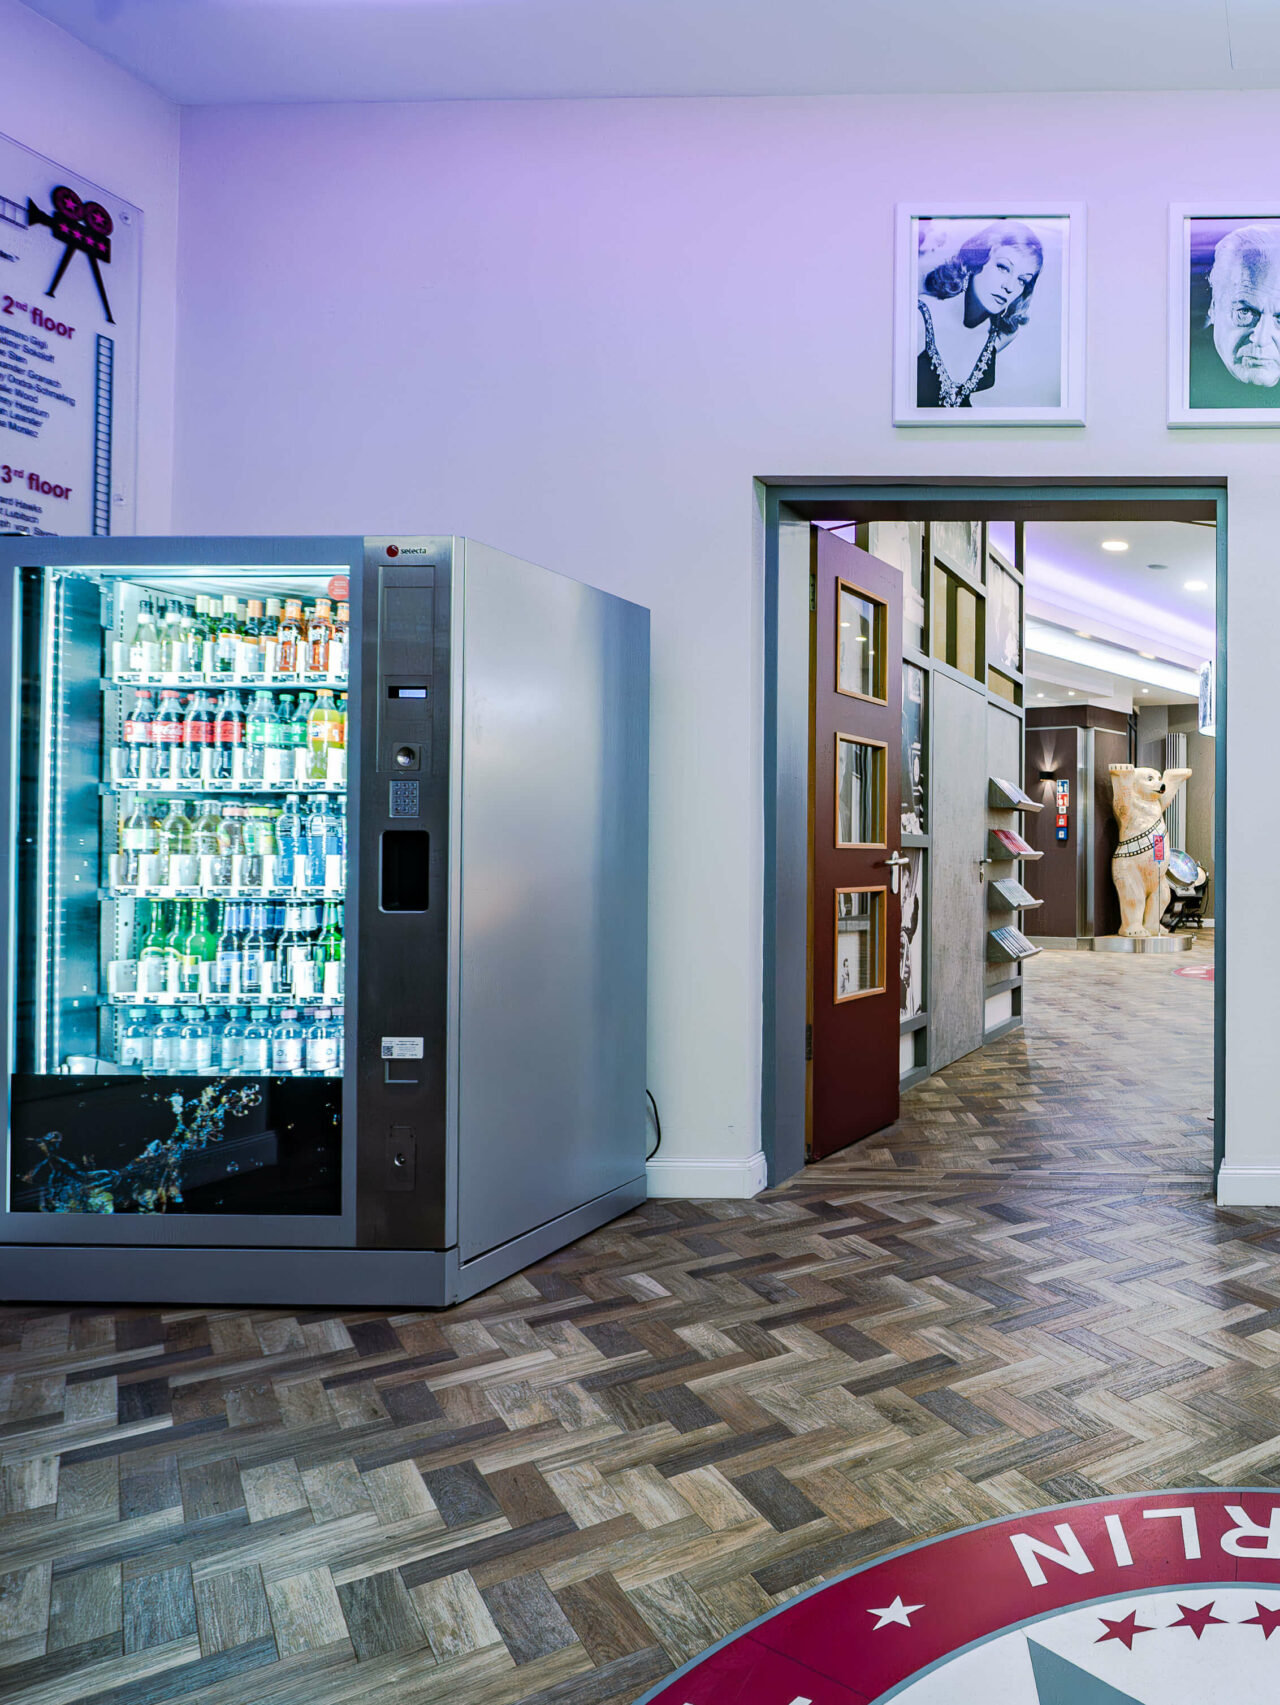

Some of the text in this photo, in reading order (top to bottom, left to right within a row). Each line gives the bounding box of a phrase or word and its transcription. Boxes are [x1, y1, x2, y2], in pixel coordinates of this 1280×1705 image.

[30, 306, 76, 339] floor
[28, 472, 72, 500] floor
[400, 547, 427, 555] selecta
